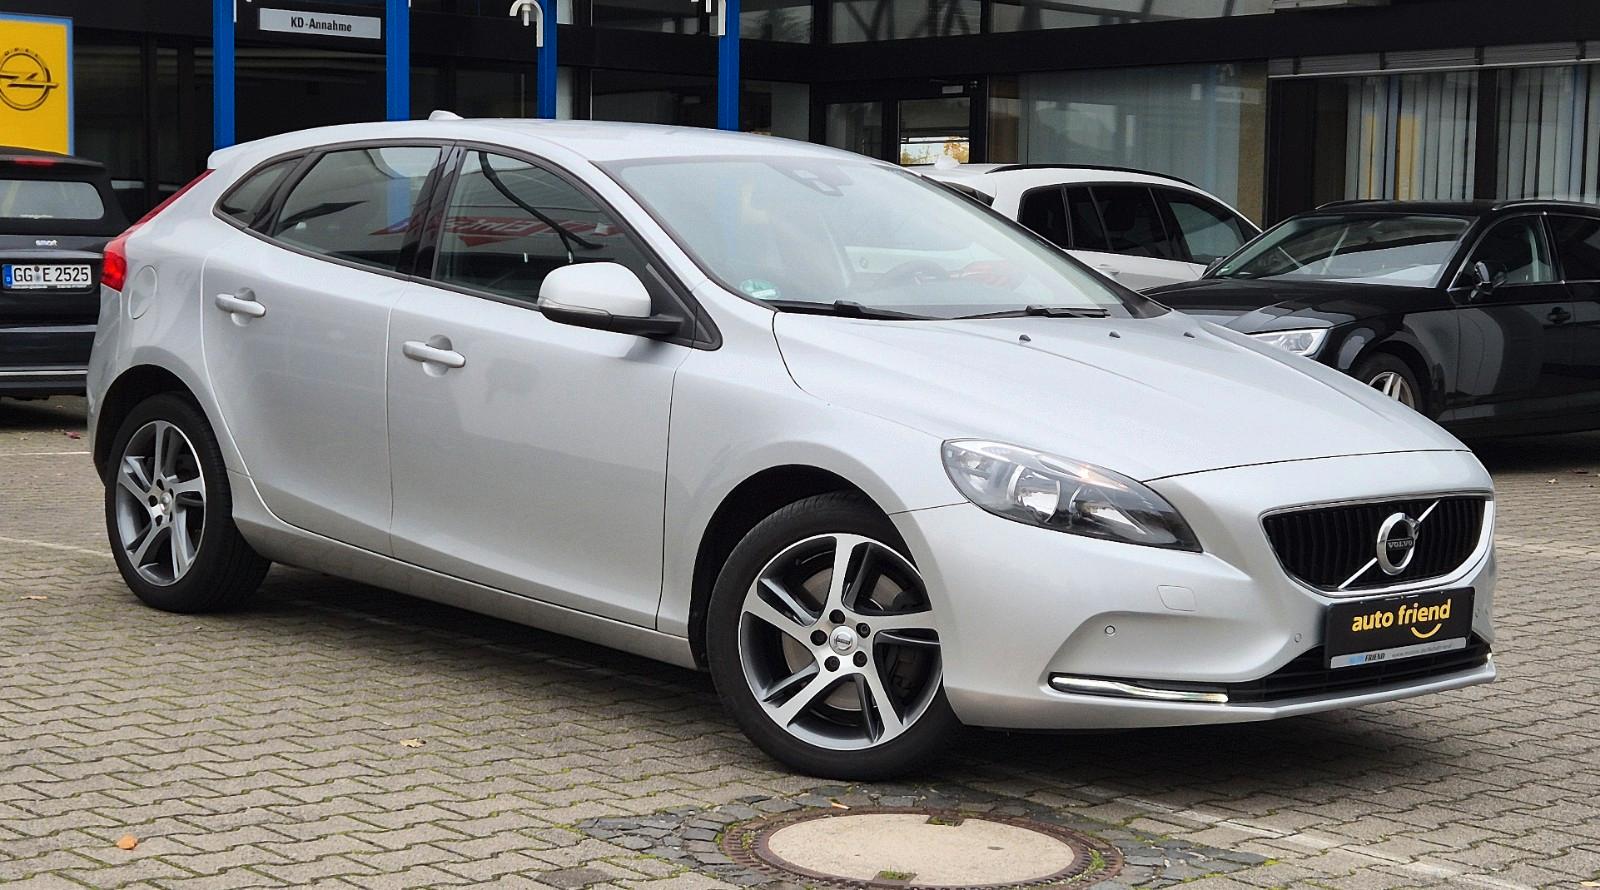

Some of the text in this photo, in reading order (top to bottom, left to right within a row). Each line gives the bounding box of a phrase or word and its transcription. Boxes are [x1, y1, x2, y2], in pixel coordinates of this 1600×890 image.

[290, 16, 352, 32] KD-Annahme
[13, 267, 33, 282] GG
[42, 267, 52, 282] E
[54, 267, 89, 282] 2525
[1387, 540, 1413, 548] VOLVO
[1352, 598, 1452, 632] auto friend
